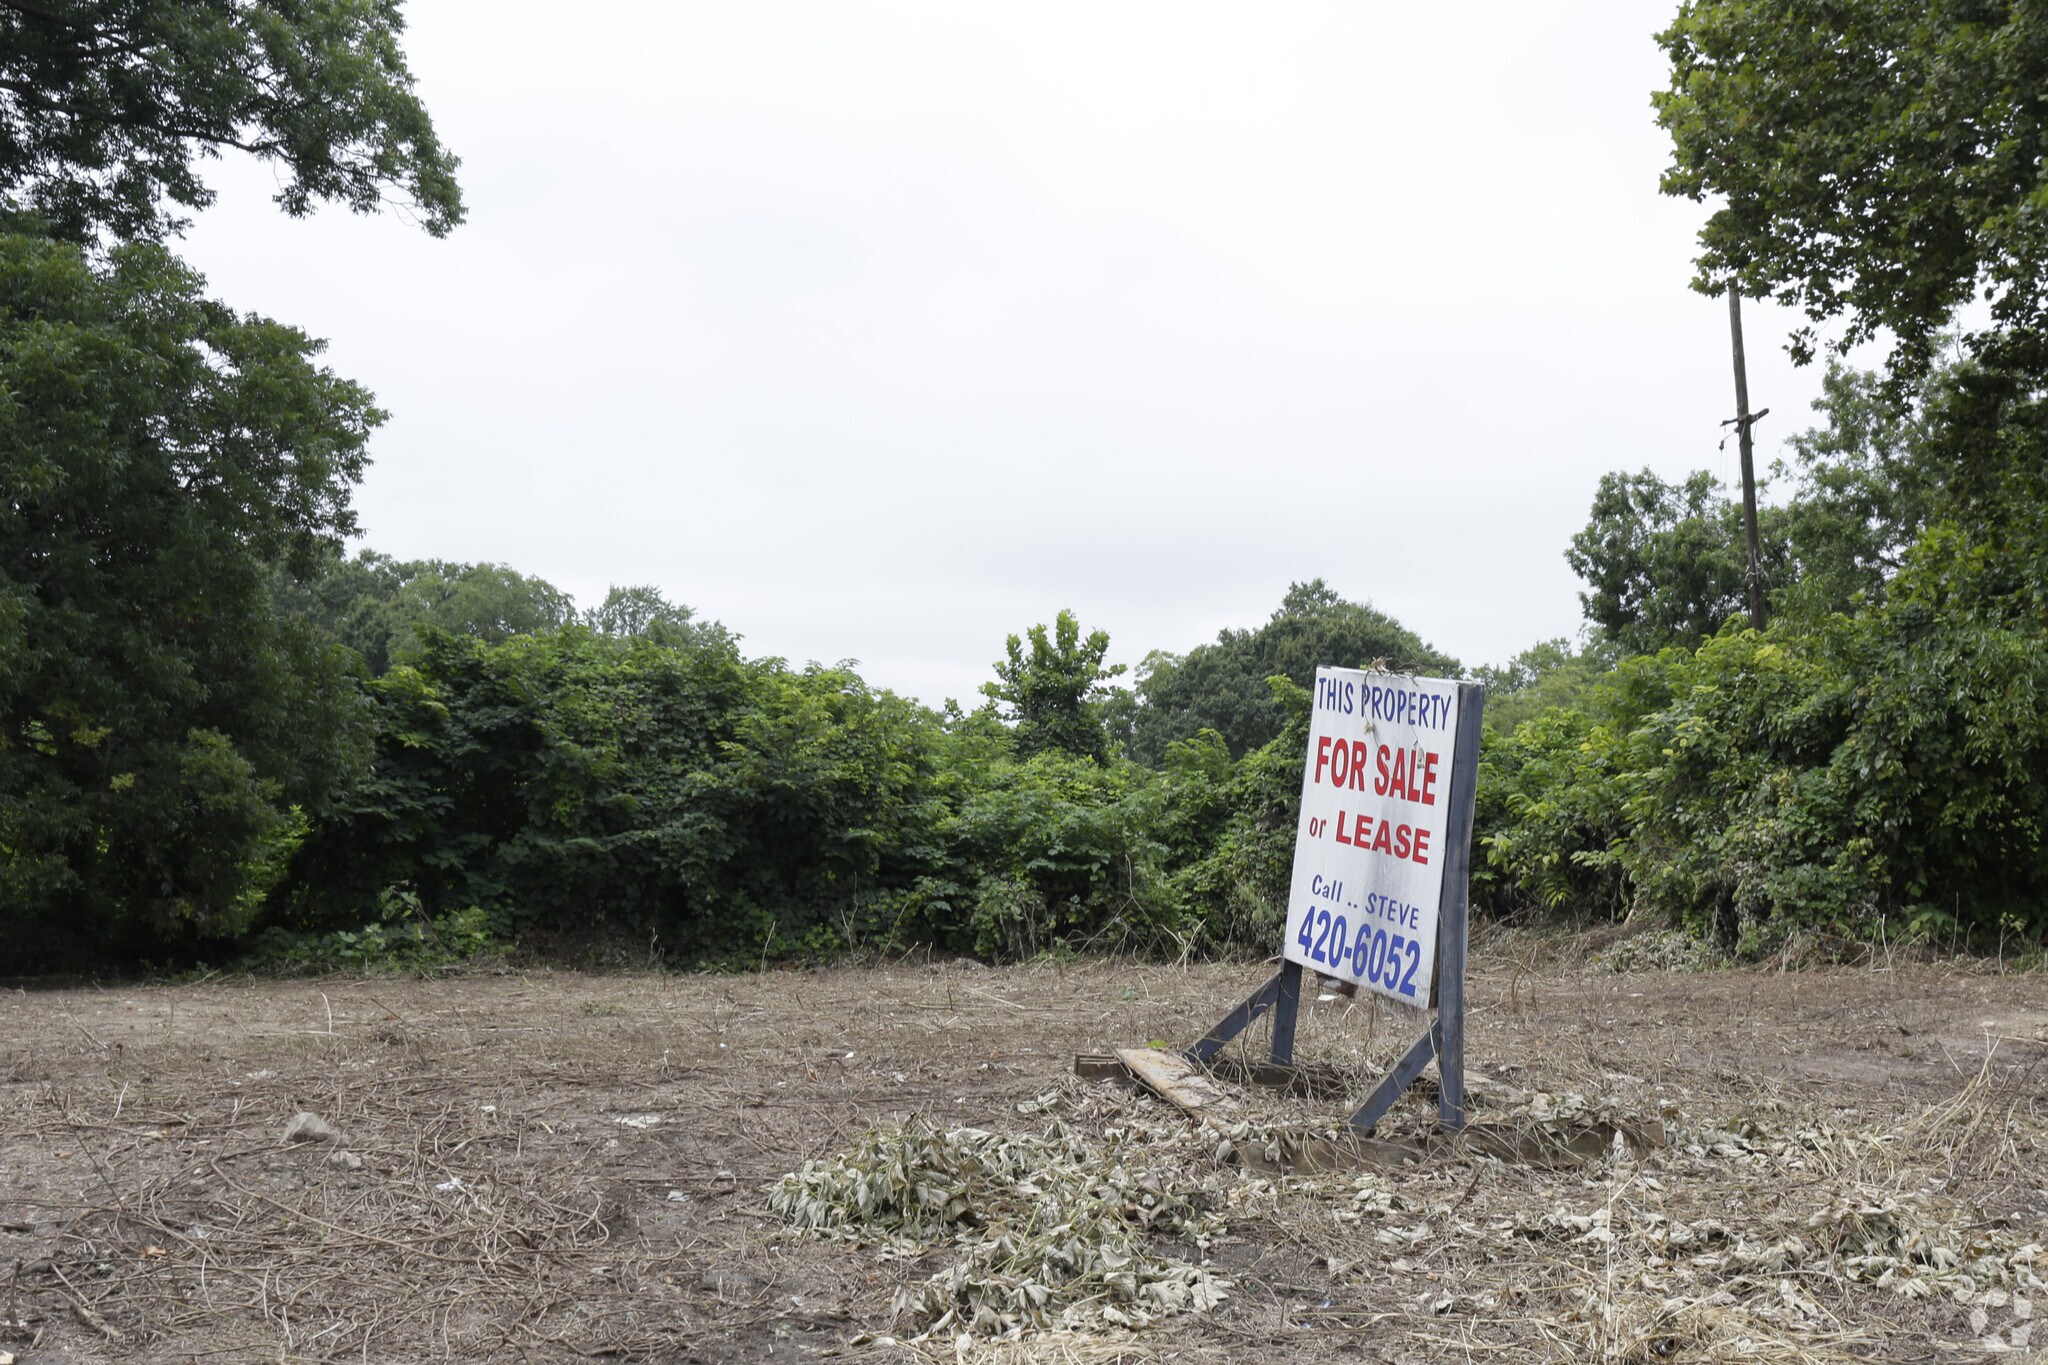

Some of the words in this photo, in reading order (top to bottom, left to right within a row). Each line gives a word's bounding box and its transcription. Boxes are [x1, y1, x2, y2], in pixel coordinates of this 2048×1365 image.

[1318, 677, 1354, 715] THIS
[1361, 684, 1452, 731] PROPERTY
[1314, 735, 1367, 792] FOR
[1374, 744, 1439, 806] SALE
[1309, 816, 1327, 839] or
[1335, 810, 1431, 865] LEASE
[1365, 892, 1420, 930] STEVE
[1297, 905, 1421, 998] 420-6052
